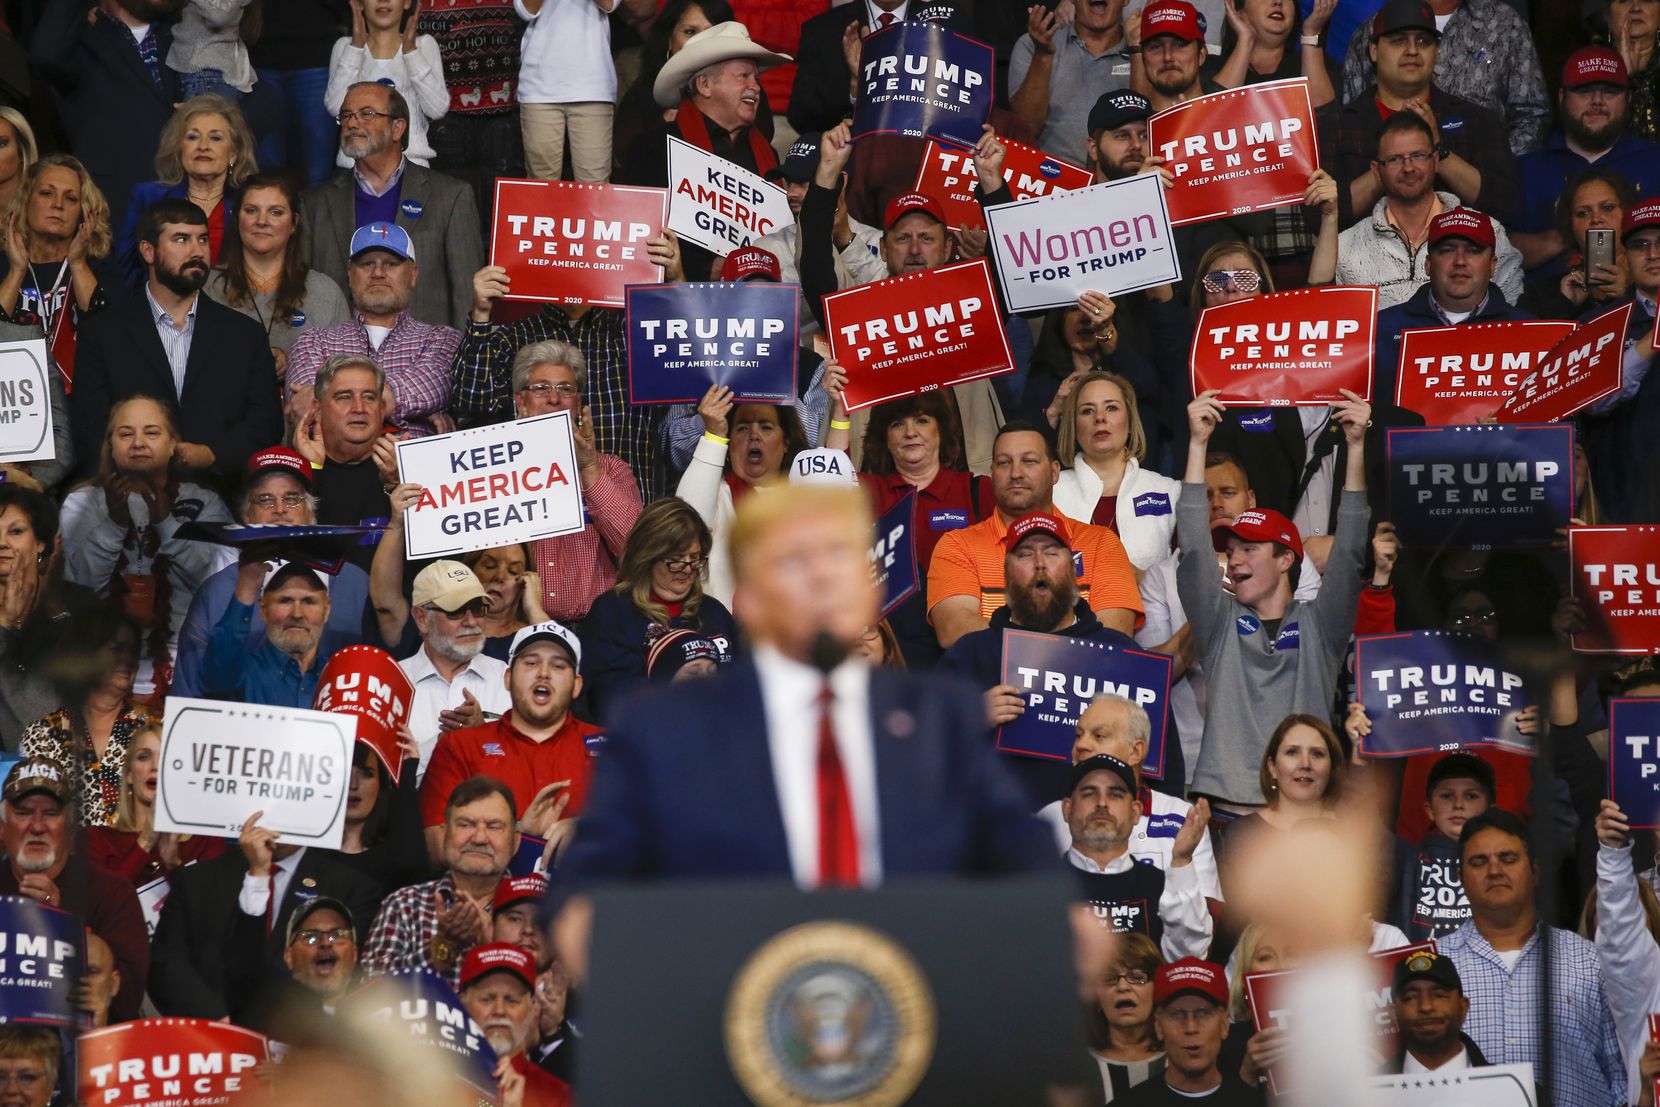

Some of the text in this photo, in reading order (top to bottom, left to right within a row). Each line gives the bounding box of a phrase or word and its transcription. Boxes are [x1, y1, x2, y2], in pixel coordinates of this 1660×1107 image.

[916, 6, 954, 18] TRUMP
[466, 37, 486, 48] HO!
[864, 54, 982, 88] TRUMP
[1578, 58, 1601, 68] MAKE
[1580, 65, 1616, 74] GREAT AGAIN
[867, 78, 970, 104] PENCE
[1109, 96, 1147, 105] TRUMP
[872, 94, 960, 112] KEEP AMERICA GREAT!
[903, 129, 922, 137] 2020
[1160, 118, 1302, 162] TRUMP
[1174, 144, 1293, 177] PENCE
[1188, 162, 1284, 187] KEEP AMERICA GREAT!
[708, 167, 764, 206] KEEP
[677, 178, 774, 237] AMERIC
[950, 193, 972, 202] KEEP
[1232, 206, 1252, 214] 2020
[1454, 214, 1480, 223] AMERICA
[1634, 212, 1650, 221] GREAT
[508, 215, 650, 242] TRUMP
[695, 211, 751, 248] GREA
[1440, 220, 1478, 228] GREAT AGAIN
[518, 240, 635, 260] PENCE
[1003, 214, 1158, 268] Women
[552, 260, 590, 269] AMERICA
[593, 262, 624, 270] GREAT!
[734, 253, 772, 264] TRUMP
[1030, 248, 1147, 283] FOR TRUMP
[640, 318, 784, 340] TRUMP
[841, 297, 982, 346] TRUMP
[1209, 320, 1360, 344] TRUMP
[654, 342, 770, 358] PENCE
[857, 324, 975, 361] PENCE
[1220, 344, 1344, 360] PENCE
[872, 342, 968, 370] KEEP AMERICA GREAT!
[1230, 361, 1332, 370] KEEP AMERICA GREAT!
[1519, 332, 1616, 392] RUMP
[920, 383, 938, 393] 2020
[1426, 374, 1518, 388] PENC
[1505, 356, 1600, 409] PENCE
[1513, 371, 1592, 414] KEEP AMERICA GREAT!
[274, 454, 303, 465] AMERICA
[450, 440, 524, 474] KEEP
[798, 455, 843, 477] USA
[1402, 461, 1559, 486] TRUMP
[414, 462, 569, 512] AMERICA
[1418, 486, 1544, 504] PENCE
[441, 498, 549, 536] GREAT!
[1030, 516, 1058, 528] AMERICA
[1016, 524, 1036, 536] GREAT
[448, 570, 469, 578] LSU
[1584, 564, 1660, 586] TRU
[1018, 667, 1156, 708] TRUMP
[1372, 664, 1523, 692] TRUMP
[318, 672, 404, 717] RUMP
[1030, 694, 1092, 715] PEN
[1387, 689, 1512, 709] PENCE
[322, 691, 395, 728] ENCE
[331, 705, 364, 713] MERICA
[1038, 713, 1060, 722] KEEP
[1398, 706, 1500, 720] KEEP AMERICA GREAT!
[1440, 743, 1459, 751] 2020
[192, 742, 334, 785] VETERANS
[203, 778, 314, 802] FOR TRUMP
[229, 824, 242, 832] 20
[1421, 864, 1464, 888] TRU
[1420, 887, 1471, 906] 202
[1094, 905, 1140, 918] UMP
[1416, 903, 1472, 918] EEP AMERICA
[17, 979, 52, 988] GREAT!
[400, 998, 486, 1038] UMP
[411, 1022, 480, 1052] NCE
[90, 1053, 256, 1088] TRUMP
[104, 1078, 241, 1104] PENCE
